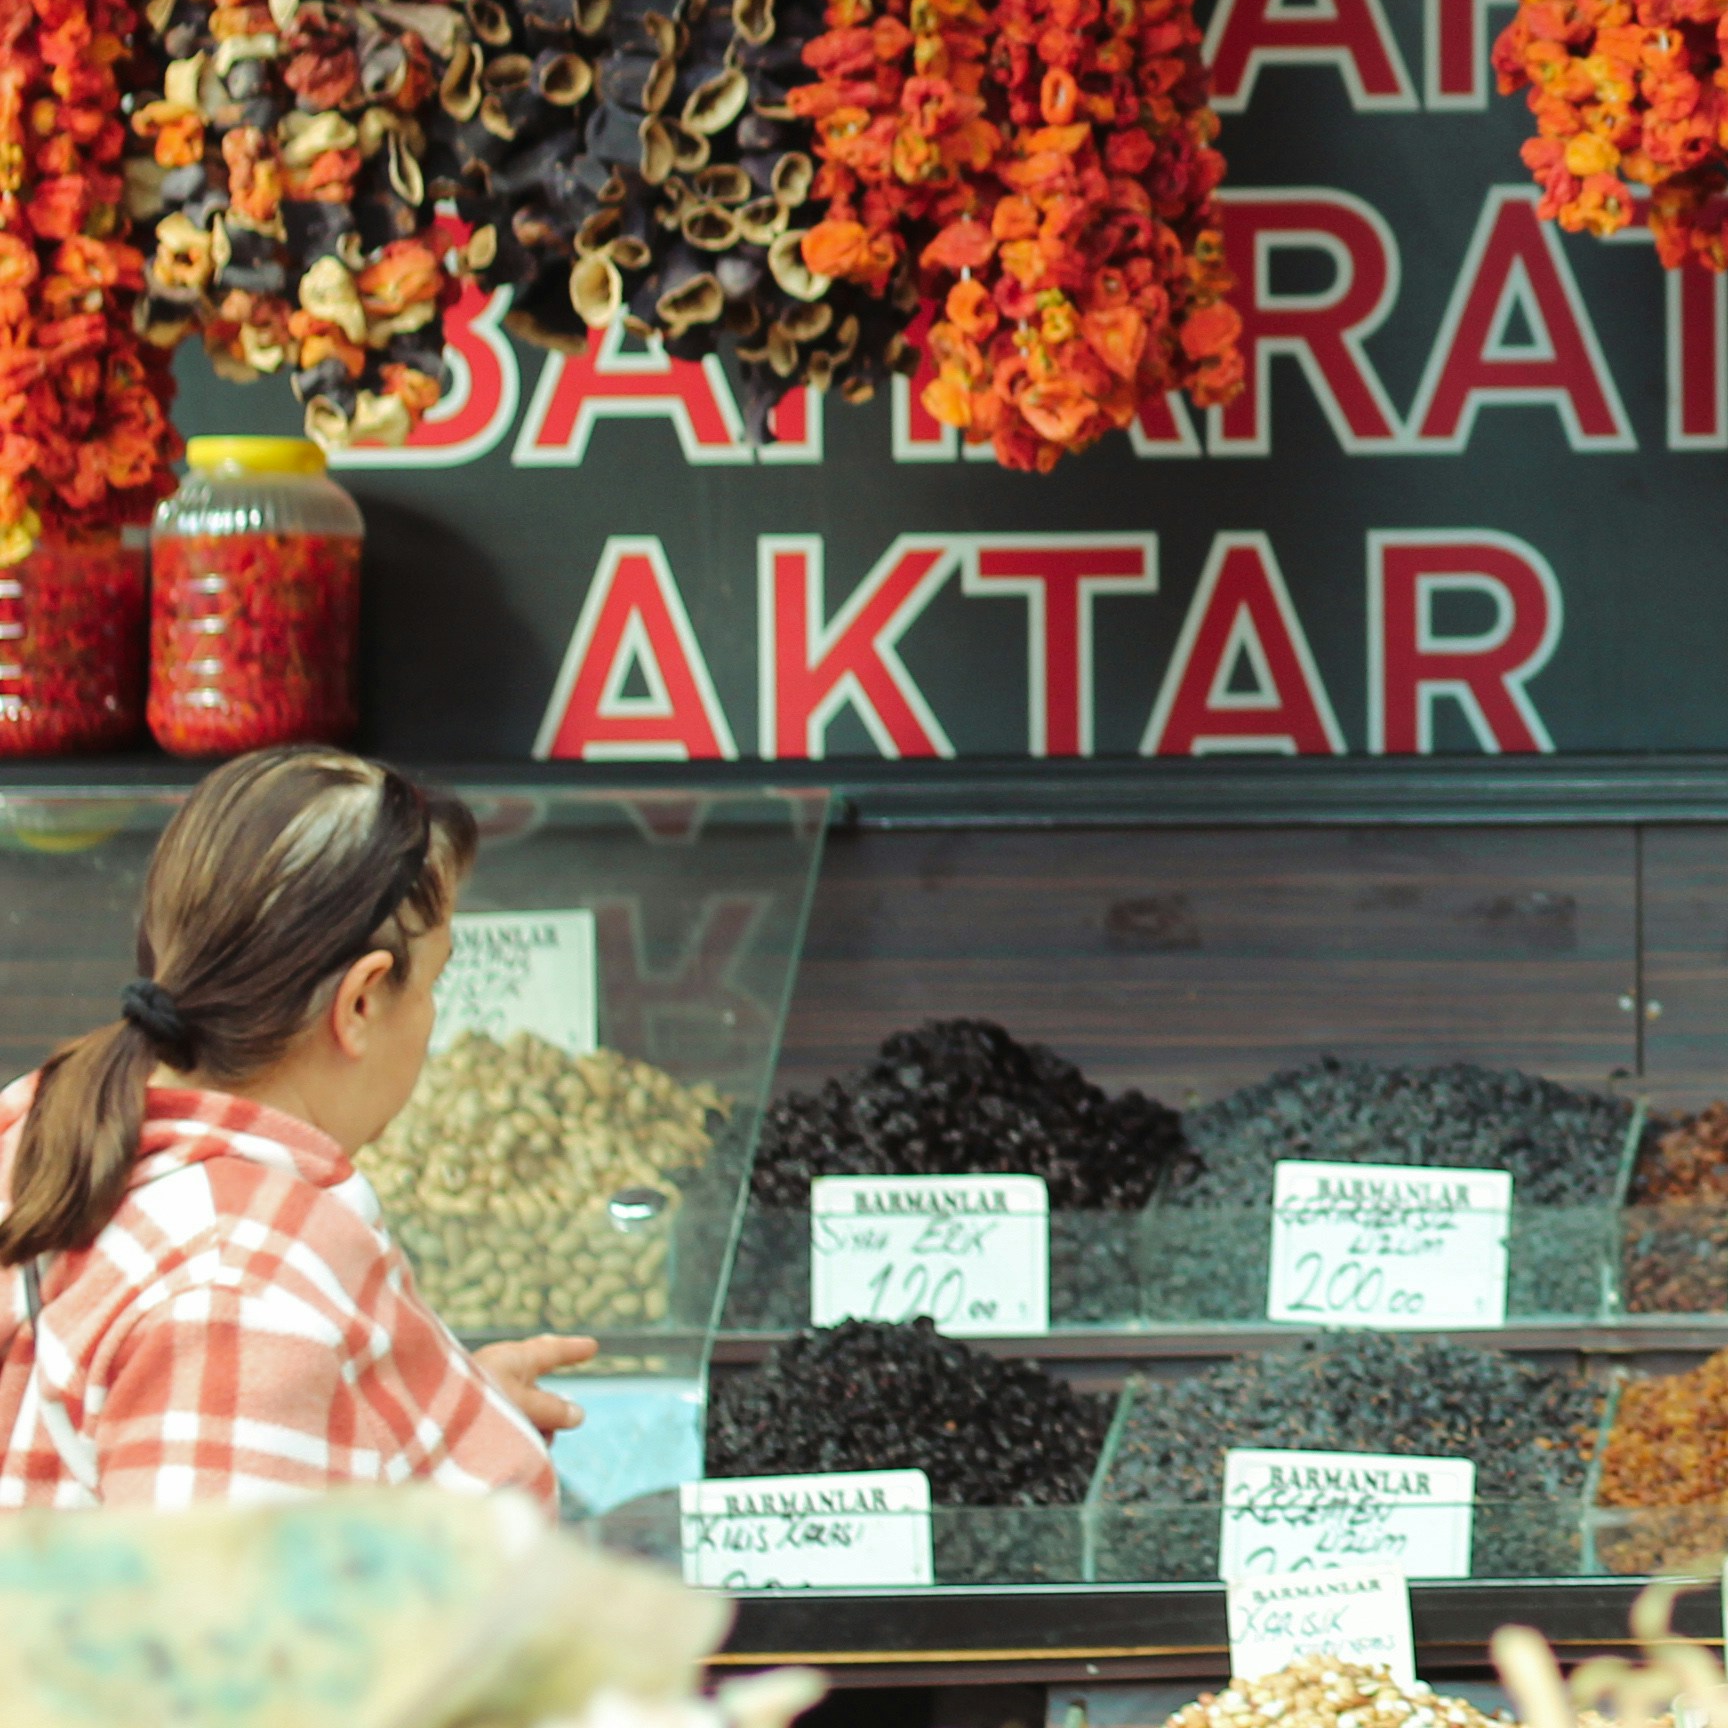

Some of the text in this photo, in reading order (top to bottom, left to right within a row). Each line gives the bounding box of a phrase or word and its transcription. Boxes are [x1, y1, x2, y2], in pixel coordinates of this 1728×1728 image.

[533, 530, 1564, 761] AKTAR
[854, 1189, 1010, 1215] BARMANLAR
[1317, 1177, 1471, 1208] BARMANLAR
[1269, 1464, 1432, 1496] BARMANLAR
[723, 1486, 890, 1515] BARMANLAR
[1251, 1578, 1383, 1604] BARMANLAR
